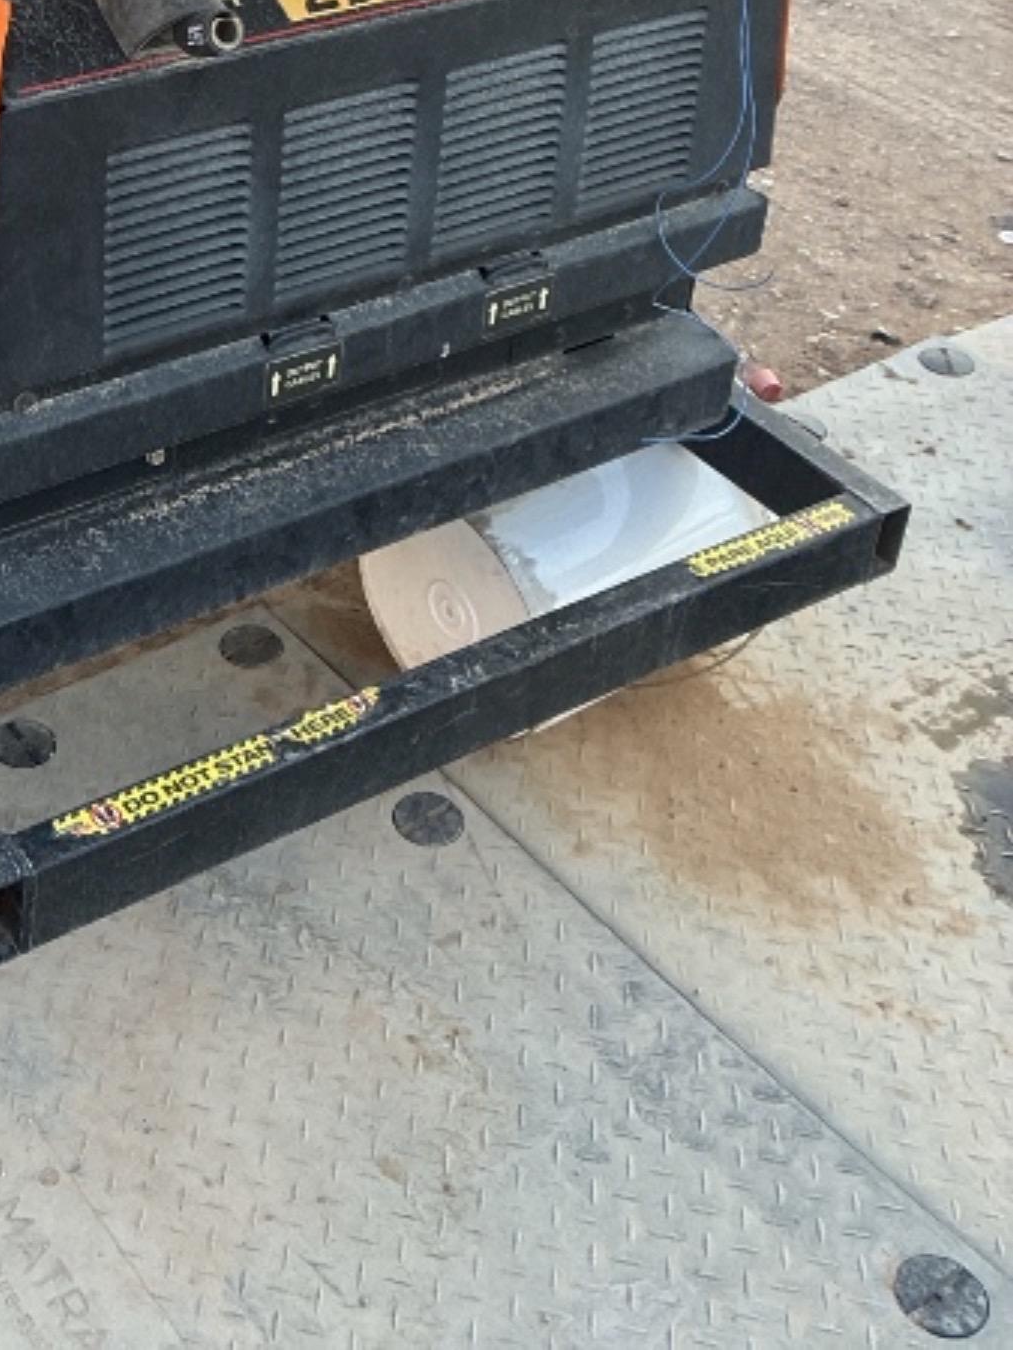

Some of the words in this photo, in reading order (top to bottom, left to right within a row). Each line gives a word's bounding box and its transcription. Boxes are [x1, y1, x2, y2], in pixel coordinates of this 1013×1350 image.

[122, 788, 160, 815] DO
[163, 767, 211, 797] NOT
[290, 707, 351, 740] HERE
